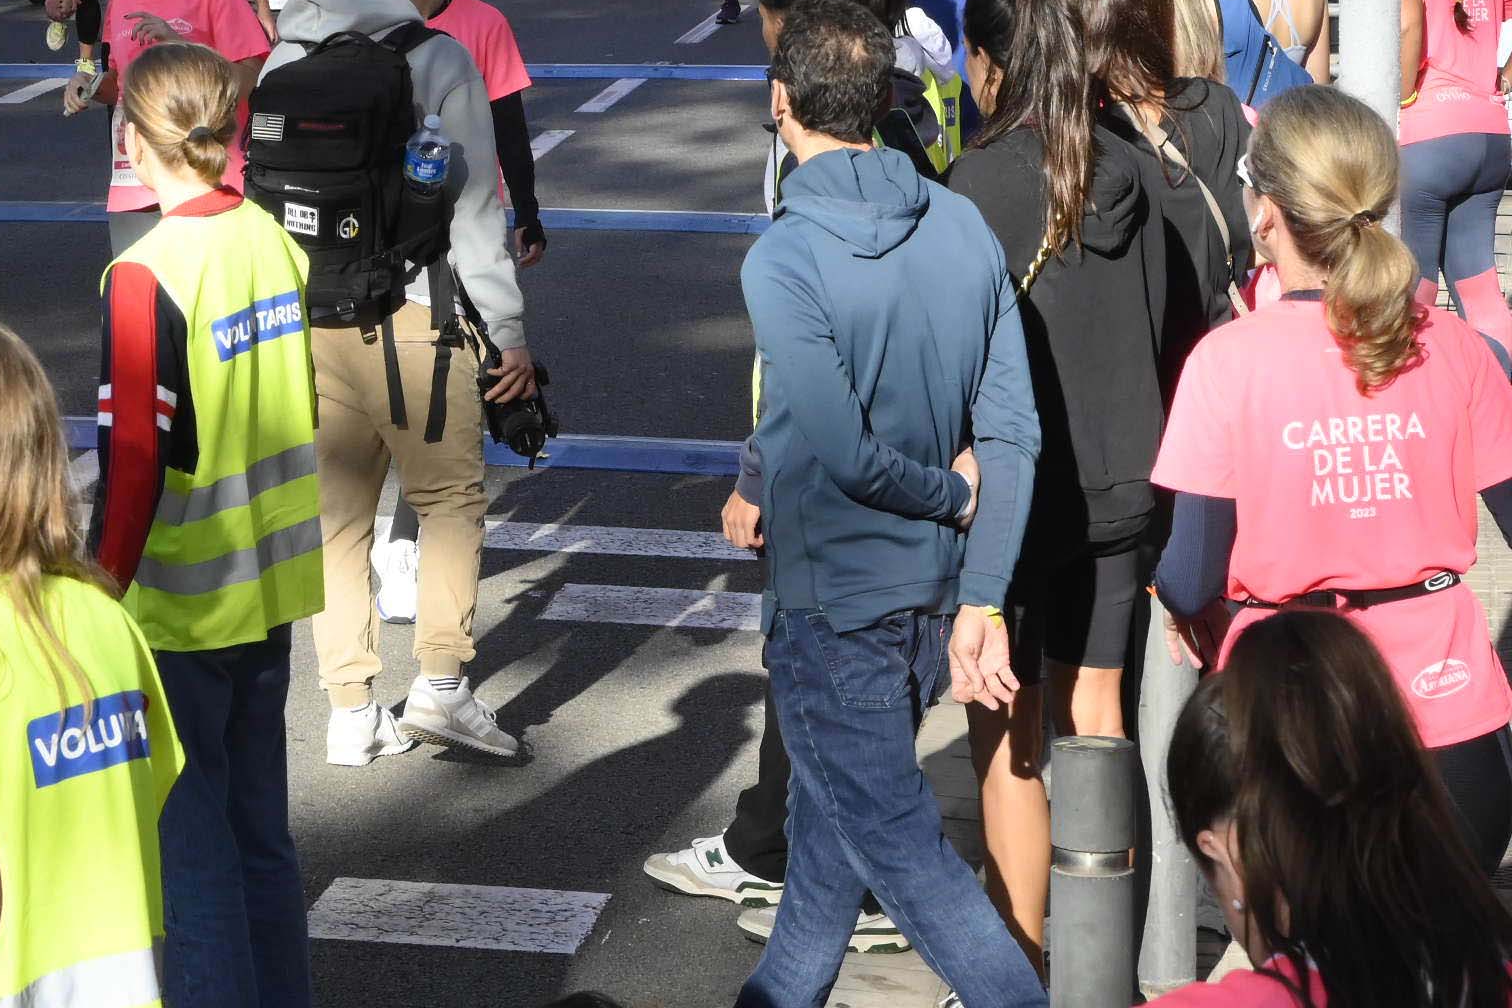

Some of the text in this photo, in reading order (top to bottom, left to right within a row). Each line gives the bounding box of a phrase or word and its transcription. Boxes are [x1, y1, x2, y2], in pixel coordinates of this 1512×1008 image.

[1282, 411, 1426, 450] CARRERA
[1314, 441, 1404, 476] DE LA
[1311, 472, 1413, 507] MUJER
[1349, 507, 1377, 519] 2023
[35, 709, 148, 767] VOLUA
